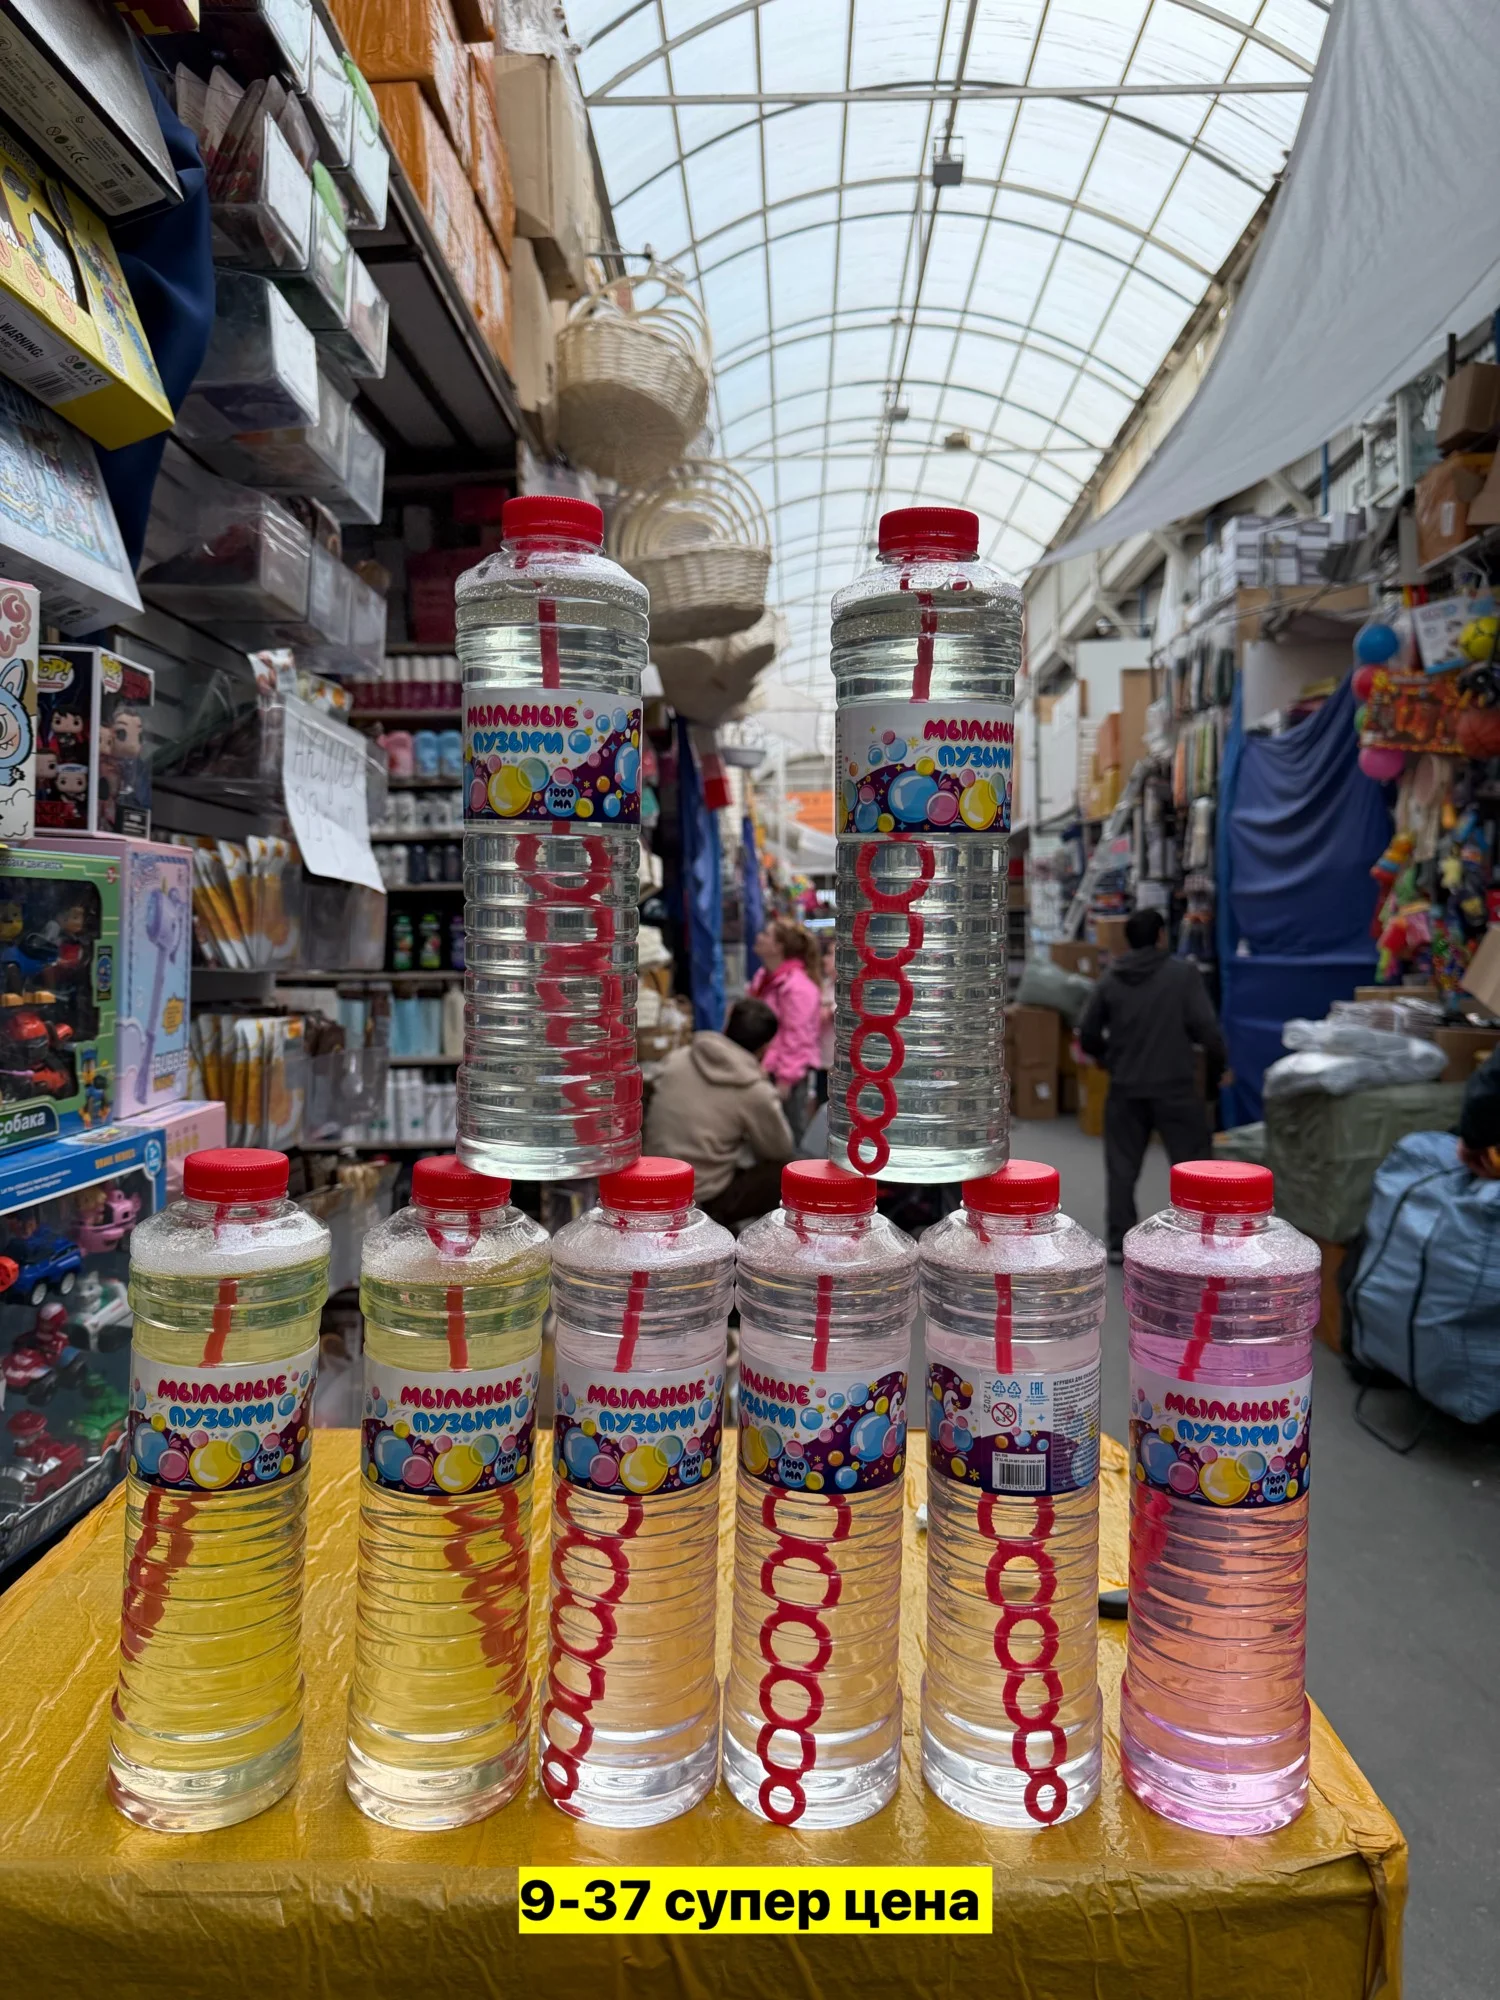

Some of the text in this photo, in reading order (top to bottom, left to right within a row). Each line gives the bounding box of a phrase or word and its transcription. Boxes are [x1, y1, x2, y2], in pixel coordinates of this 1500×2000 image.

[0, 323, 44, 358] WARNING:
[467, 704, 579, 729] МЫЛЬНЫЕ
[473, 731, 564, 754] ПУЗЫРИ
[548, 788, 574, 798] 1000
[157, 1374, 288, 1404] МЫЛЬНЫЕ
[401, 1377, 523, 1409] МЫЛЬНЫЕ
[587, 1379, 706, 1409] МЫЛЬНЫЕ
[169, 1401, 274, 1429] ПУЗЫРИ
[412, 1404, 512, 1434] ПУЗЫРИ
[599, 1406, 696, 1434] ПУЗЫРИ
[1164, 1392, 1290, 1423] МЫЛЬНЫЕ
[1177, 1419, 1279, 1447] ПУЗЫРИ
[258, 1450, 280, 1464] 1000
[498, 1452, 516, 1467] 1000
[682, 1455, 701, 1468] 1000
[782, 1458, 805, 1471] 1000
[1265, 1474, 1286, 1485] 1000
